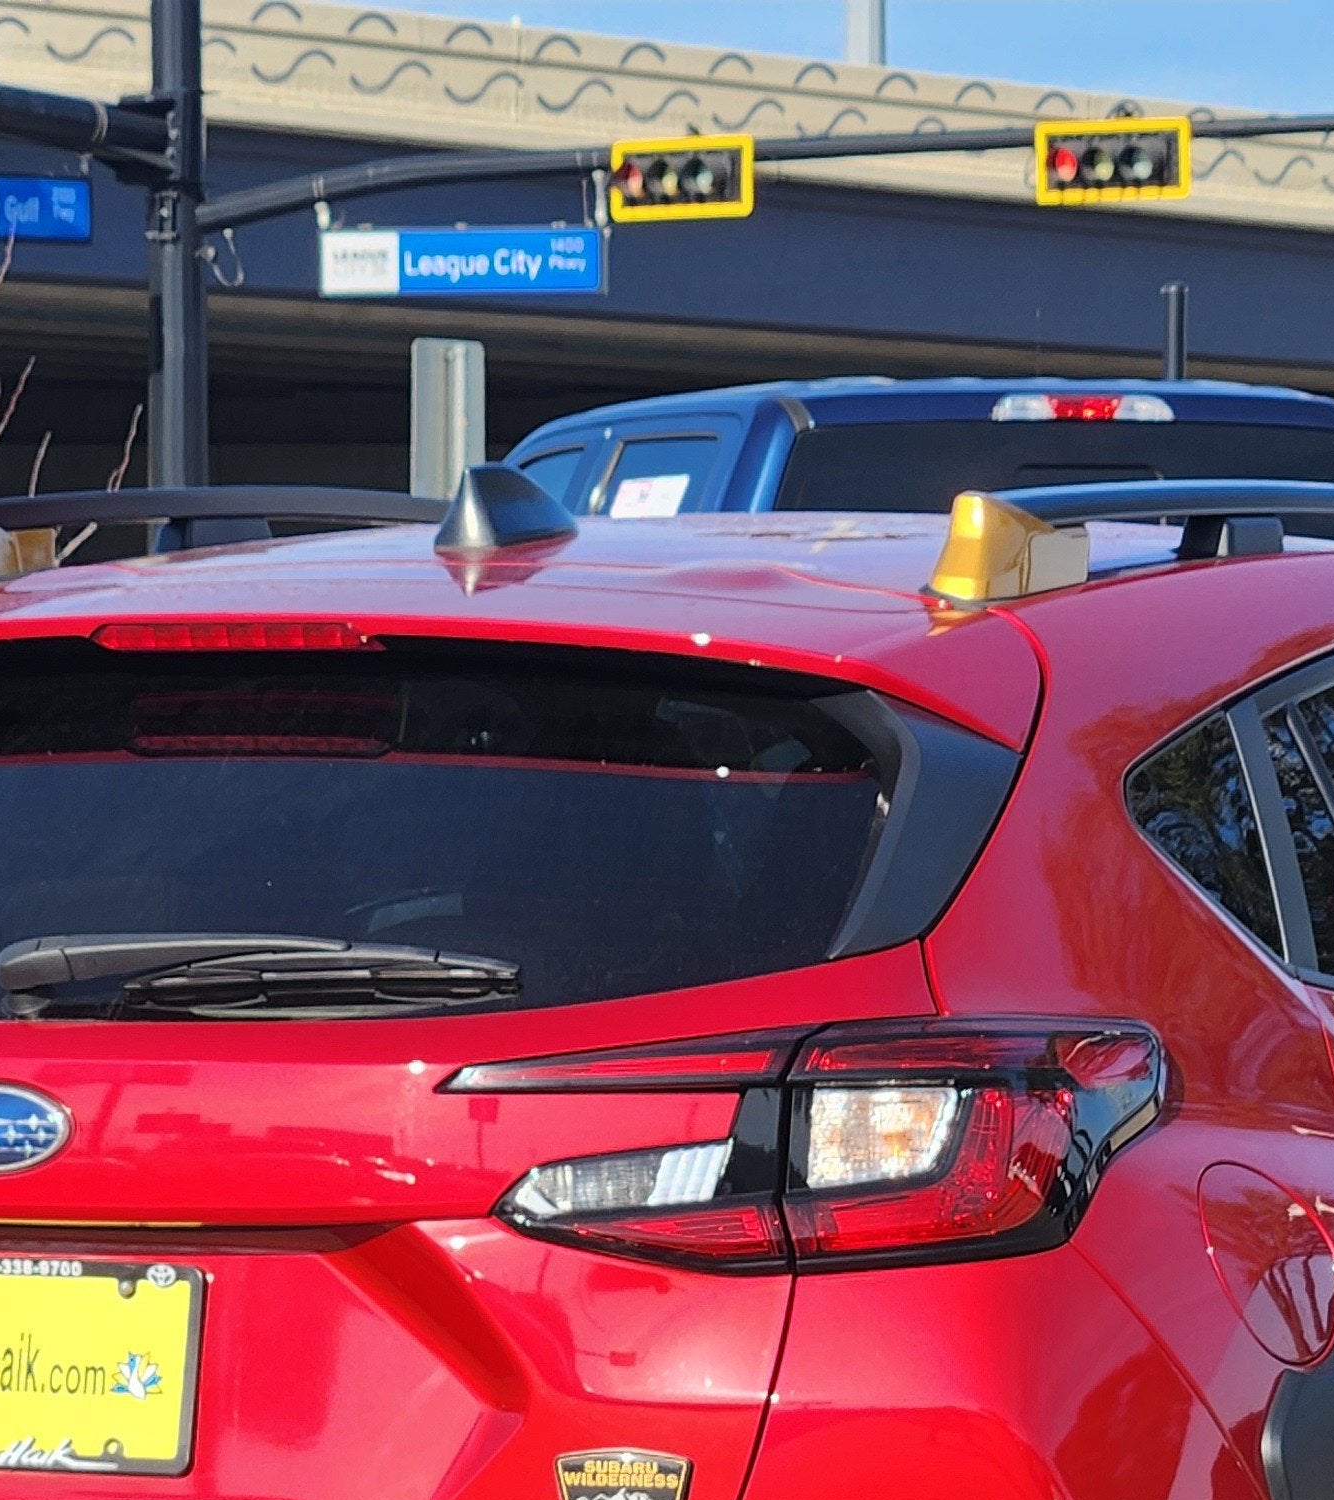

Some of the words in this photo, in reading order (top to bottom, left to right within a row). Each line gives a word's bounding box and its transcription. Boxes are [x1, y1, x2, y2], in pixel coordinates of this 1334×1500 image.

[403, 250, 490, 283] League
[493, 248, 543, 281] City
[583, 1459, 659, 1475] SUBARU
[564, 1471, 679, 1489] WILDERNESS
